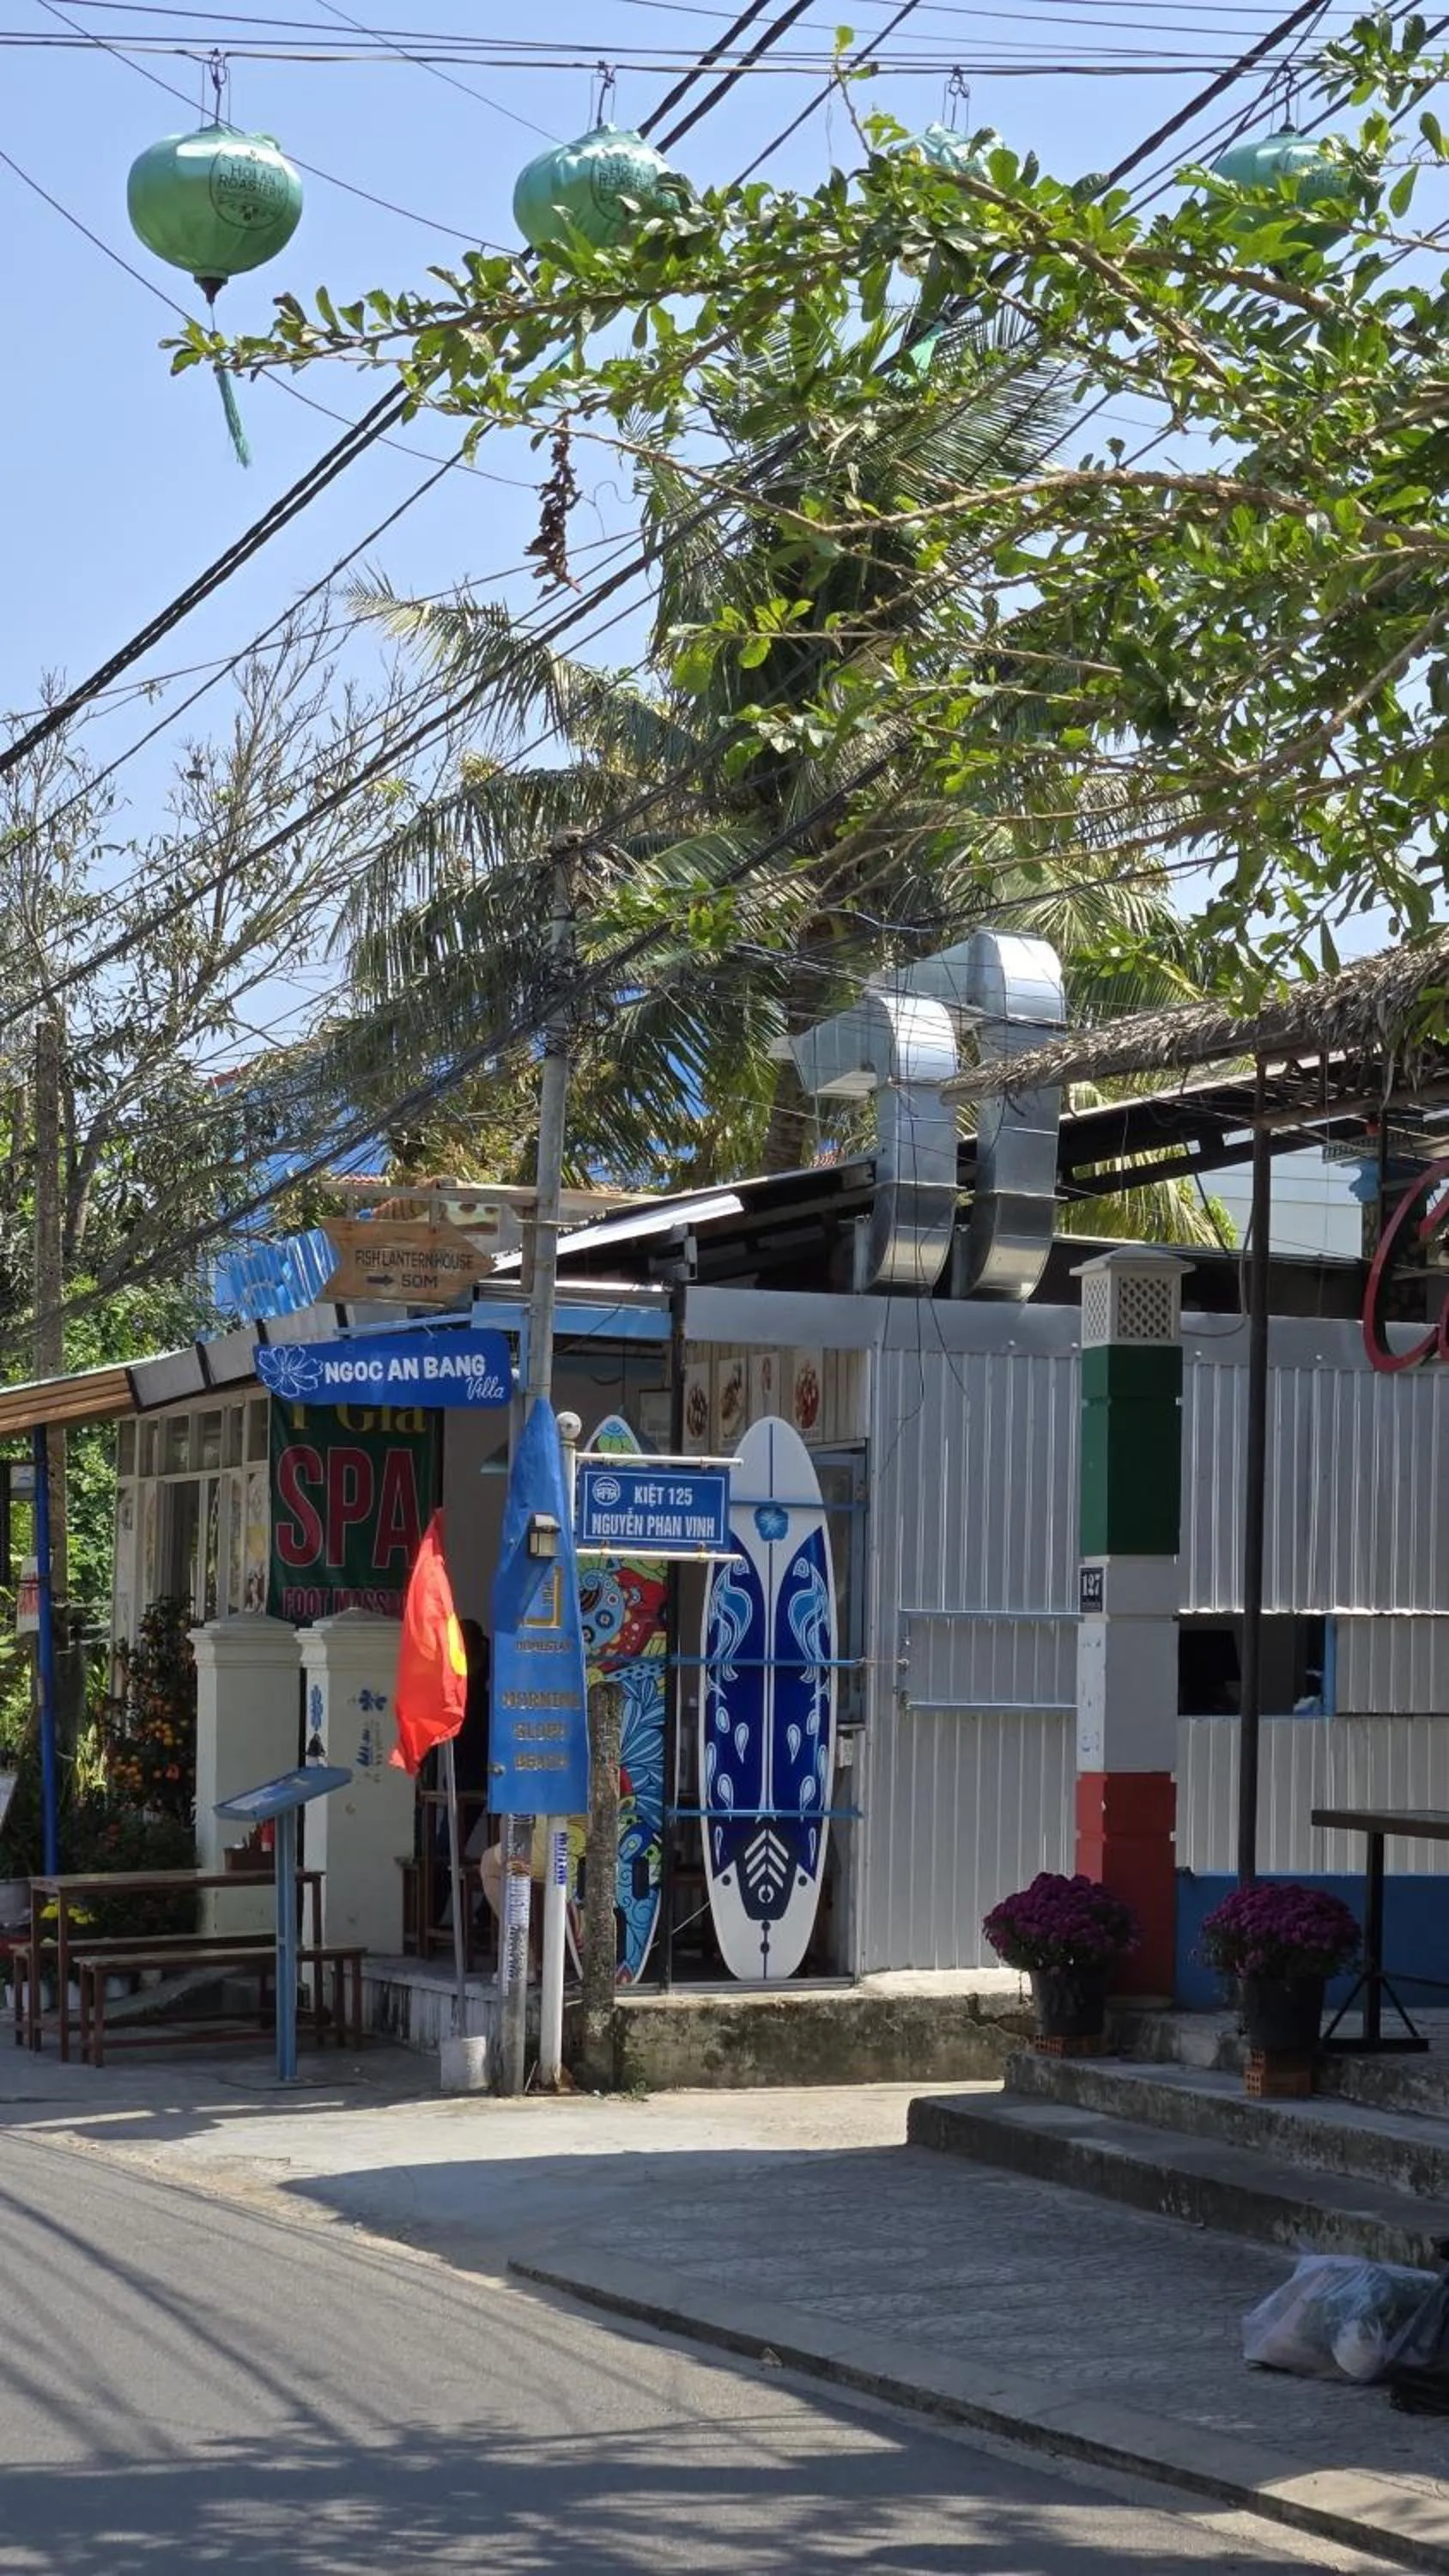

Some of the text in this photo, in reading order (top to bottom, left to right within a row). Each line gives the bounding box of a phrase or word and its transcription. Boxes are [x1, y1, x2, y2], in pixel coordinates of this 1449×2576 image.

[219, 174, 284, 197] ROASTERY
[231, 164, 276, 185] HOI AN
[355, 1249, 473, 1271] FISH LANTERN HOUSE
[400, 1274, 439, 1289] 50M
[324, 1353, 486, 1384] NGOC AN BANG
[465, 1376, 506, 1400] Villa
[276, 1444, 422, 1569] SPA
[634, 1483, 694, 1508] KIỆT 125
[591, 1508, 715, 1539] NGUYỄN PHAN VINH
[282, 1587, 329, 1619] FOOT
